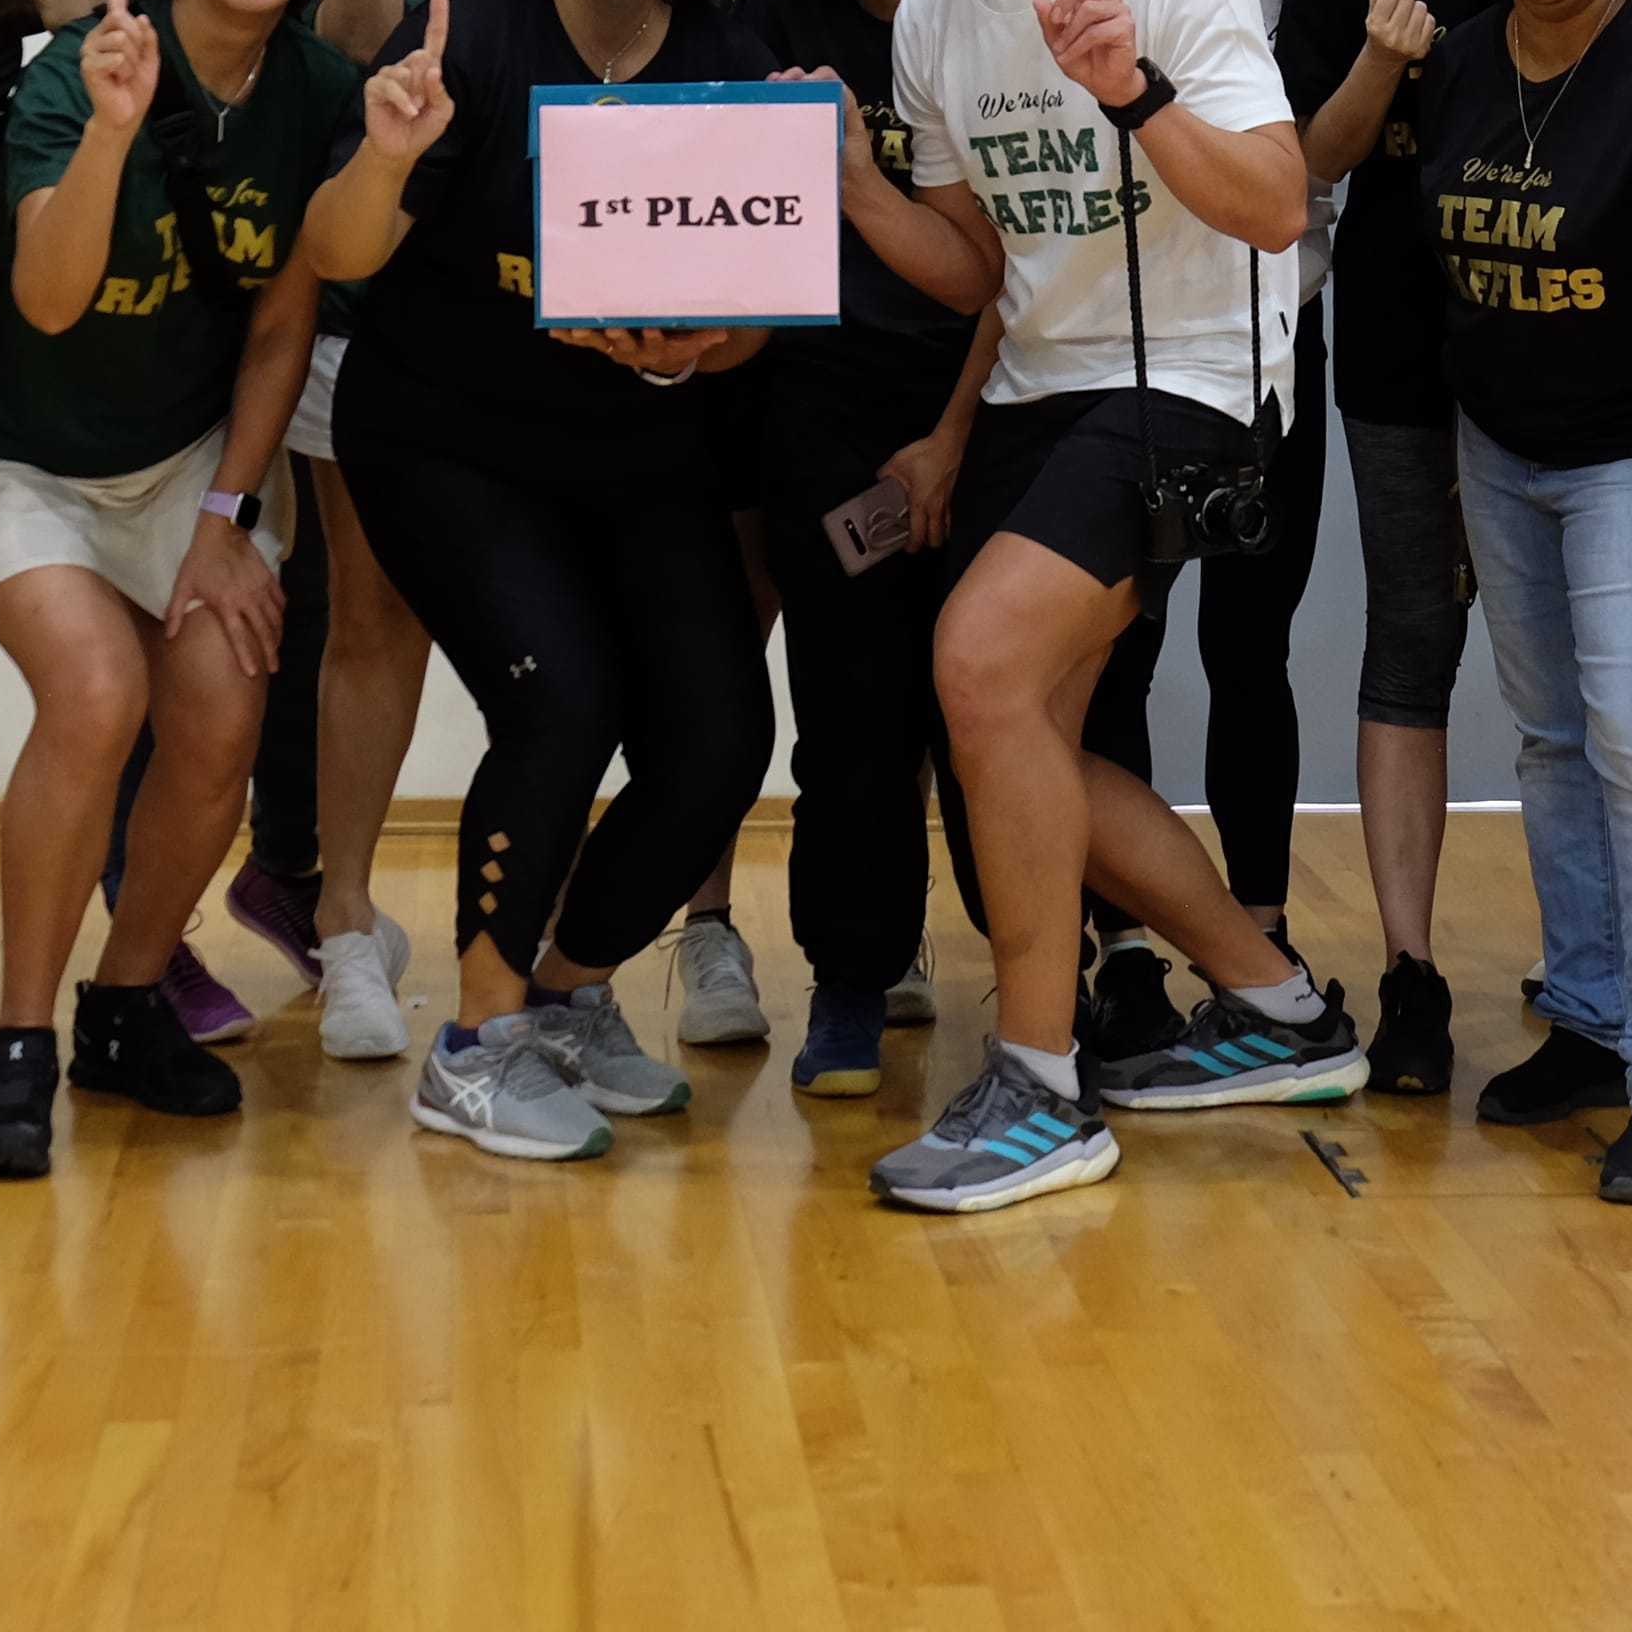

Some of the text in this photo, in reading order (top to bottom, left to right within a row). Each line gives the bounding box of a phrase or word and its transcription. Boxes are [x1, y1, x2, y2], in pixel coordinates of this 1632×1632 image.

[977, 88, 1065, 120] We're for
[969, 127, 1100, 178] TEAM
[1462, 156, 1554, 192] We're for
[224, 176, 270, 208] for
[577, 194, 804, 228] 1st PLACE
[1436, 193, 1567, 253] TEAM
